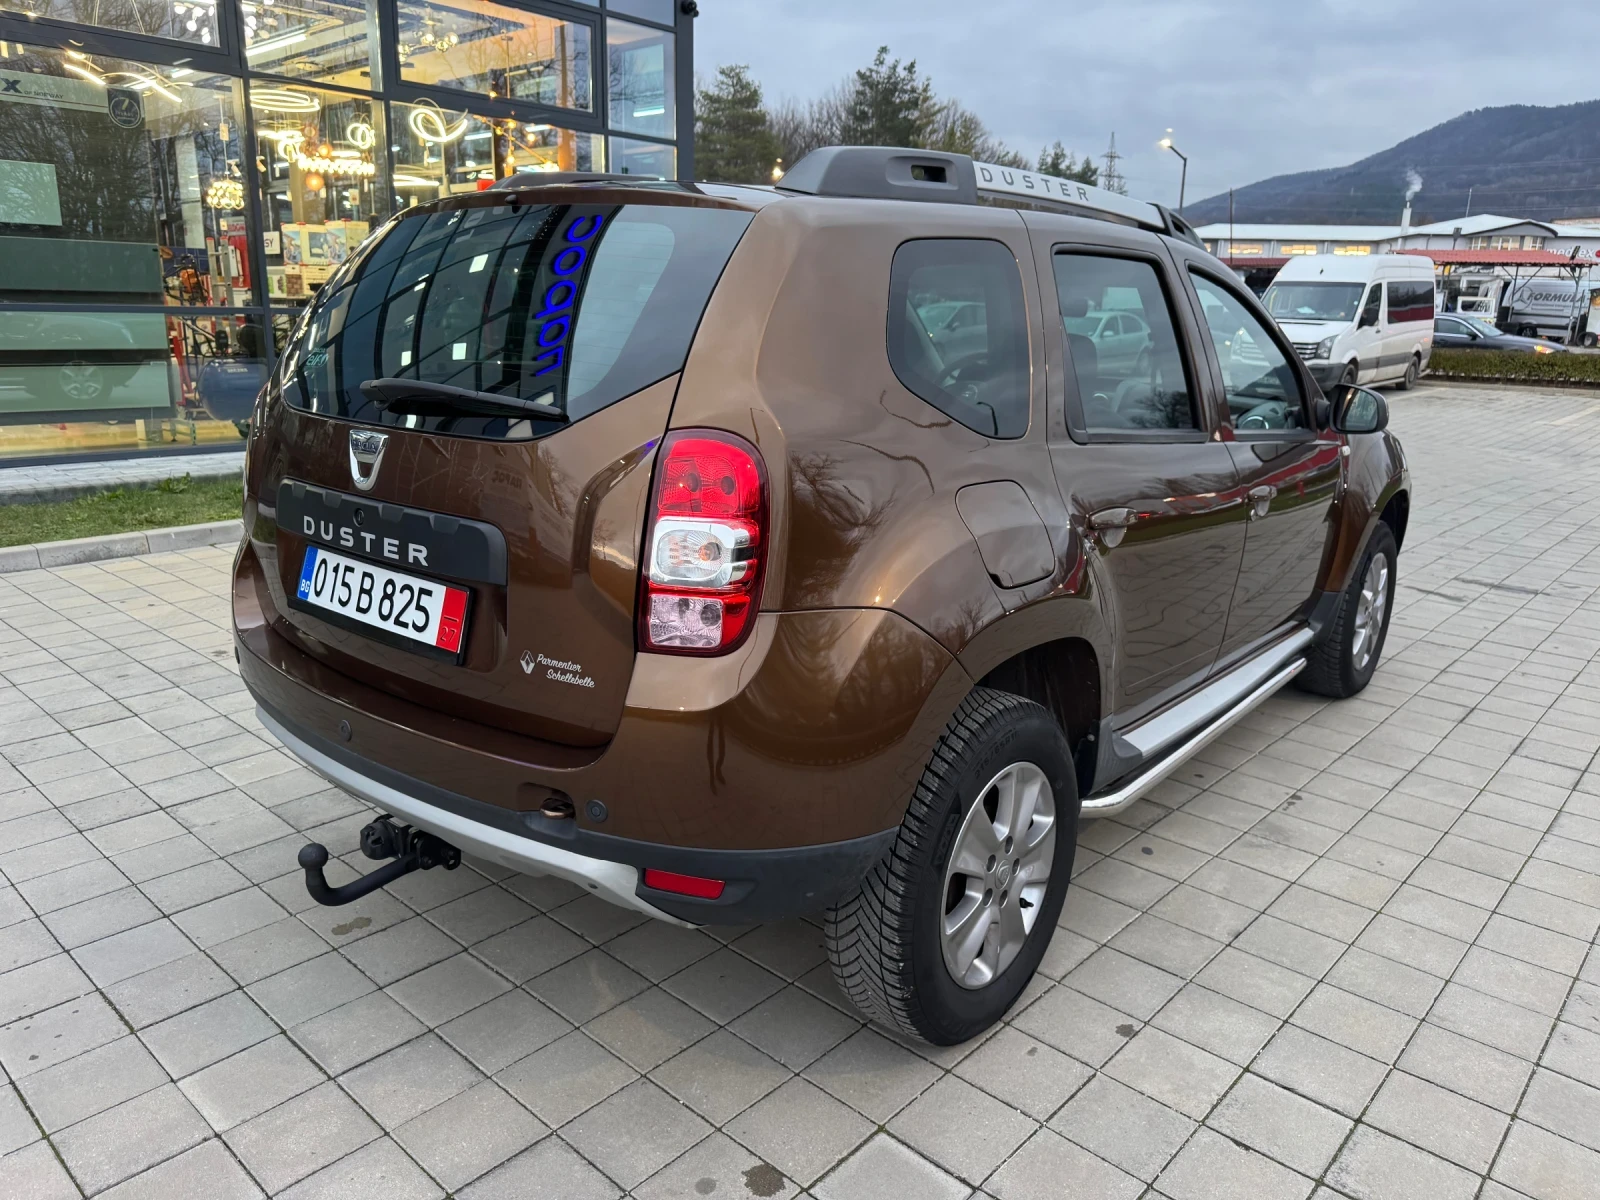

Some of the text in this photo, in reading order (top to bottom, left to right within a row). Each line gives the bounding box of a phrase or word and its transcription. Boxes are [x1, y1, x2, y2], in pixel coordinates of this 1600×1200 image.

[34, 91, 63, 99] NORWAY
[979, 167, 1089, 201] DUSTER
[1546, 246, 1595, 258] medex
[303, 515, 428, 566] DUSTER
[300, 579, 311, 593] BG
[440, 626, 457, 643] 27
[536, 653, 582, 672] Parmentier
[546, 668, 595, 688] Schellebelle
